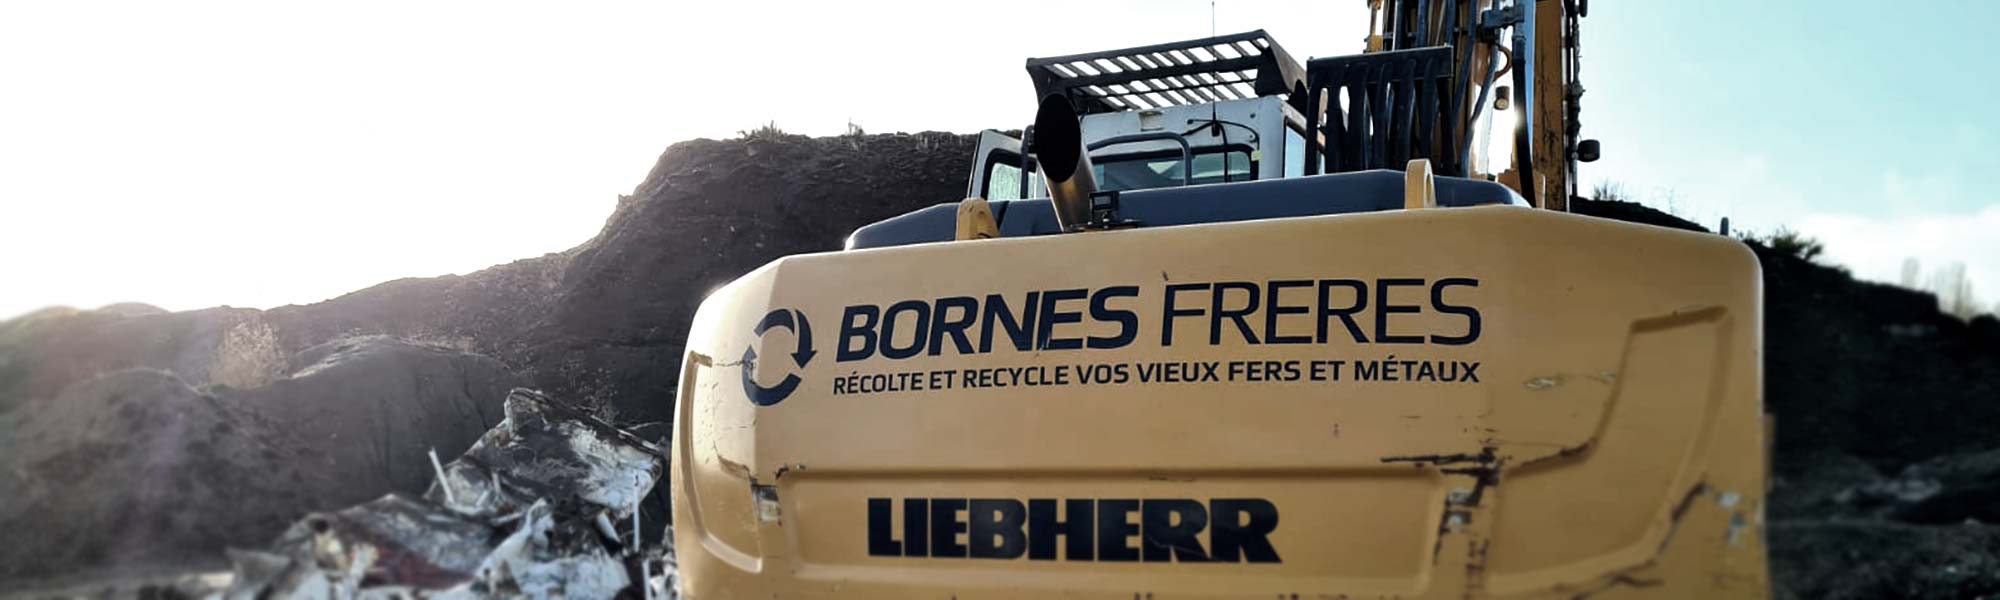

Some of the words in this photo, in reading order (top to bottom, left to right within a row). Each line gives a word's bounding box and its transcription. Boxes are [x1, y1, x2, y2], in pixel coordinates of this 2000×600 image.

[836, 286, 1140, 362] BORNES
[1160, 277, 1482, 347] FRERES
[833, 370, 924, 395] RÉCOLTE
[929, 369, 956, 389] ET
[962, 365, 1069, 389] RECYCLE
[1076, 362, 1130, 384] VOS
[1136, 361, 1221, 383] VIEUX
[1227, 360, 1301, 382] FERS
[1309, 360, 1346, 382] ET
[1353, 355, 1481, 383] MÉTAUX
[867, 497, 1283, 563] LIEBHERR
